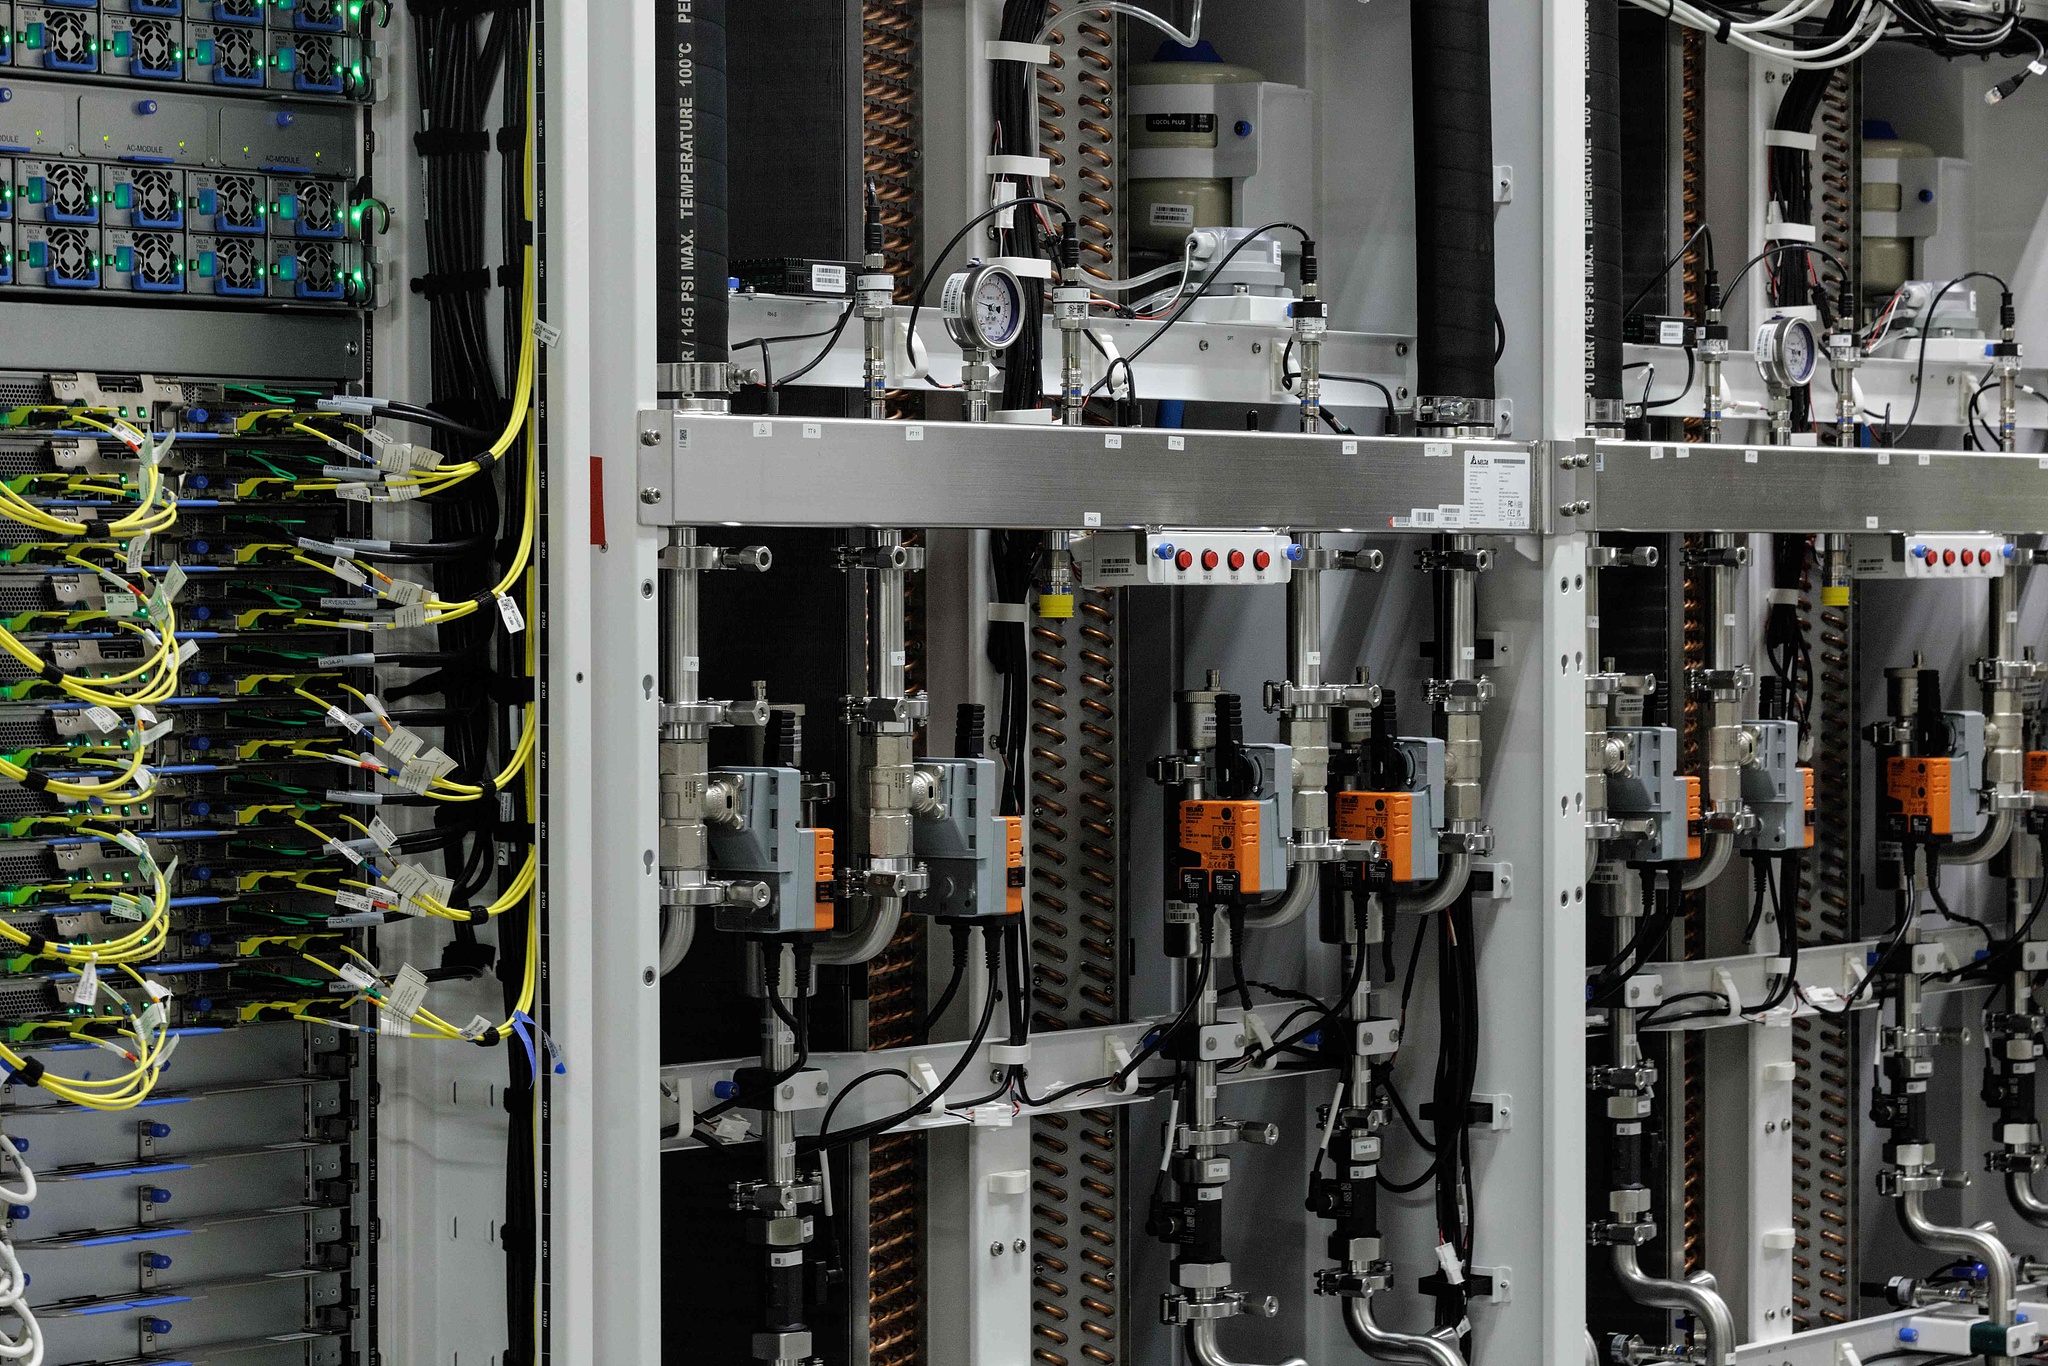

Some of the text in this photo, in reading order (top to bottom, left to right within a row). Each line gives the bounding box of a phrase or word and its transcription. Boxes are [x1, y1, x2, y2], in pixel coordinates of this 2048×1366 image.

[678, 42, 692, 87] 100°C
[126, 144, 163, 154] AC-MODULE
[679, 97, 693, 219] TEMPERATURE
[1585, 138, 1593, 235] TEMPERATURE
[680, 229, 694, 270] MAX.
[1585, 244, 1594, 278] MAX.
[681, 276, 694, 302] PSI
[1585, 282, 1594, 303] PSI
[681, 308, 695, 336] 145
[1585, 307, 1594, 330] 145
[1585, 341, 1595, 369] BAR
